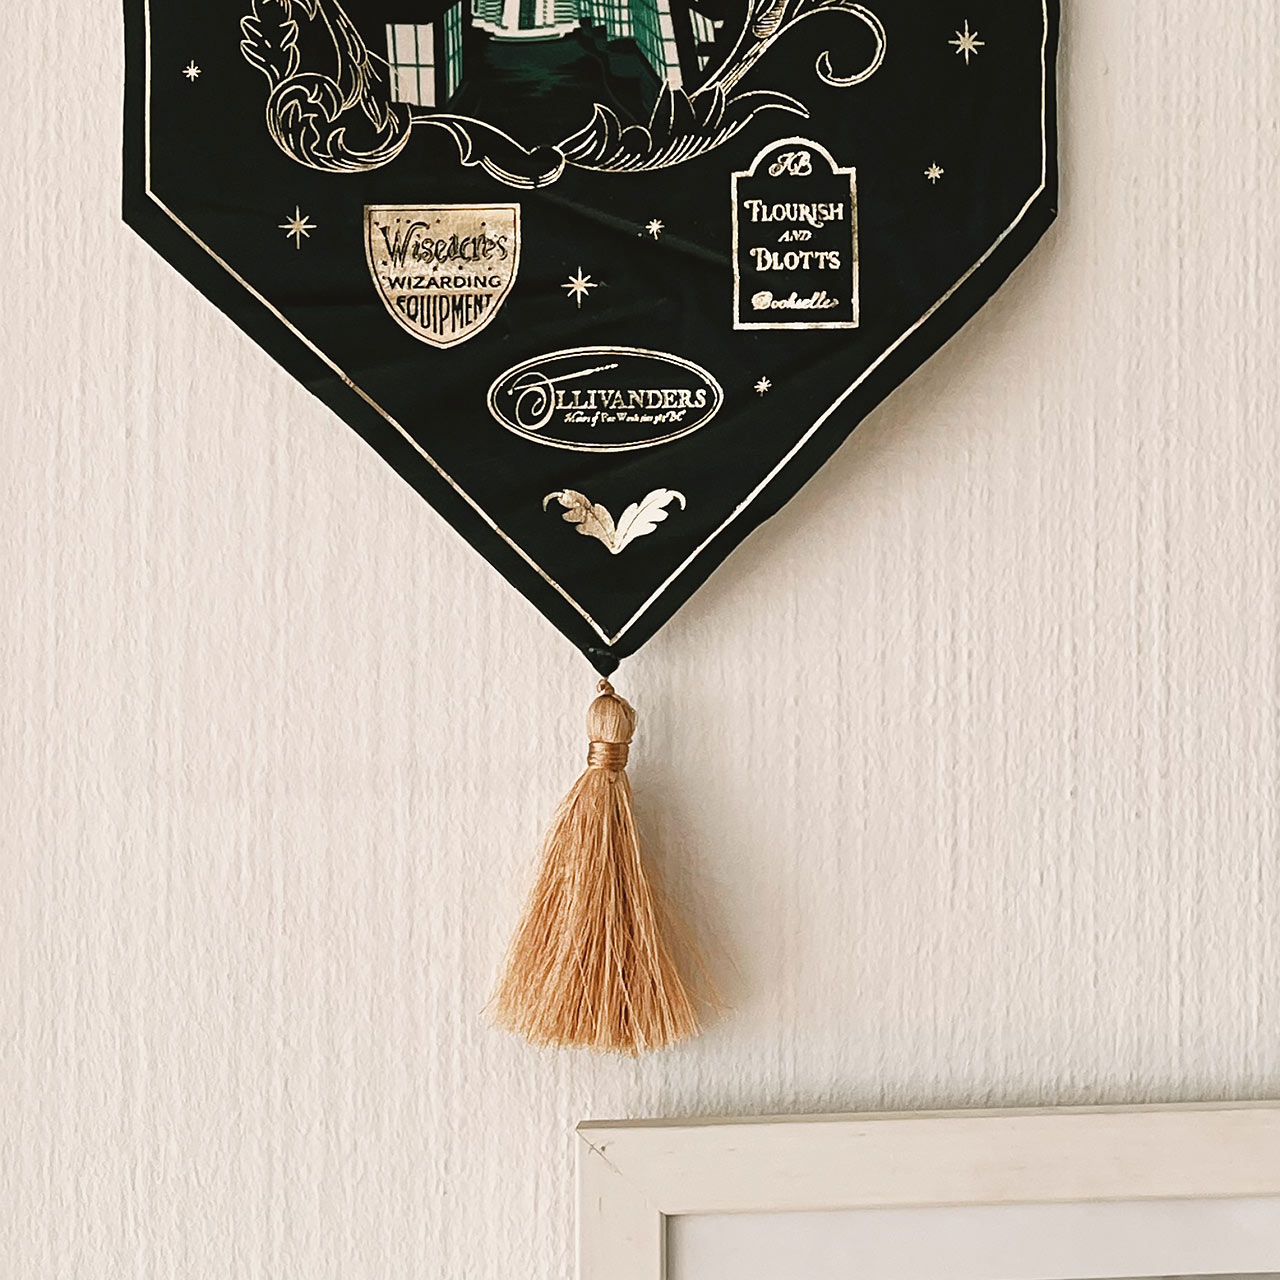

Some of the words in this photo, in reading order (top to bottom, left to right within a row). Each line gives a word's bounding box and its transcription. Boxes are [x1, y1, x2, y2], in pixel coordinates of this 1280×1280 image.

[743, 199, 844, 228] FLOURISH
[777, 229, 813, 243] AND
[387, 275, 502, 290] WIZARDING
[396, 293, 494, 336] EQUIPMENT
[510, 371, 707, 431] OLLIVANDERS
